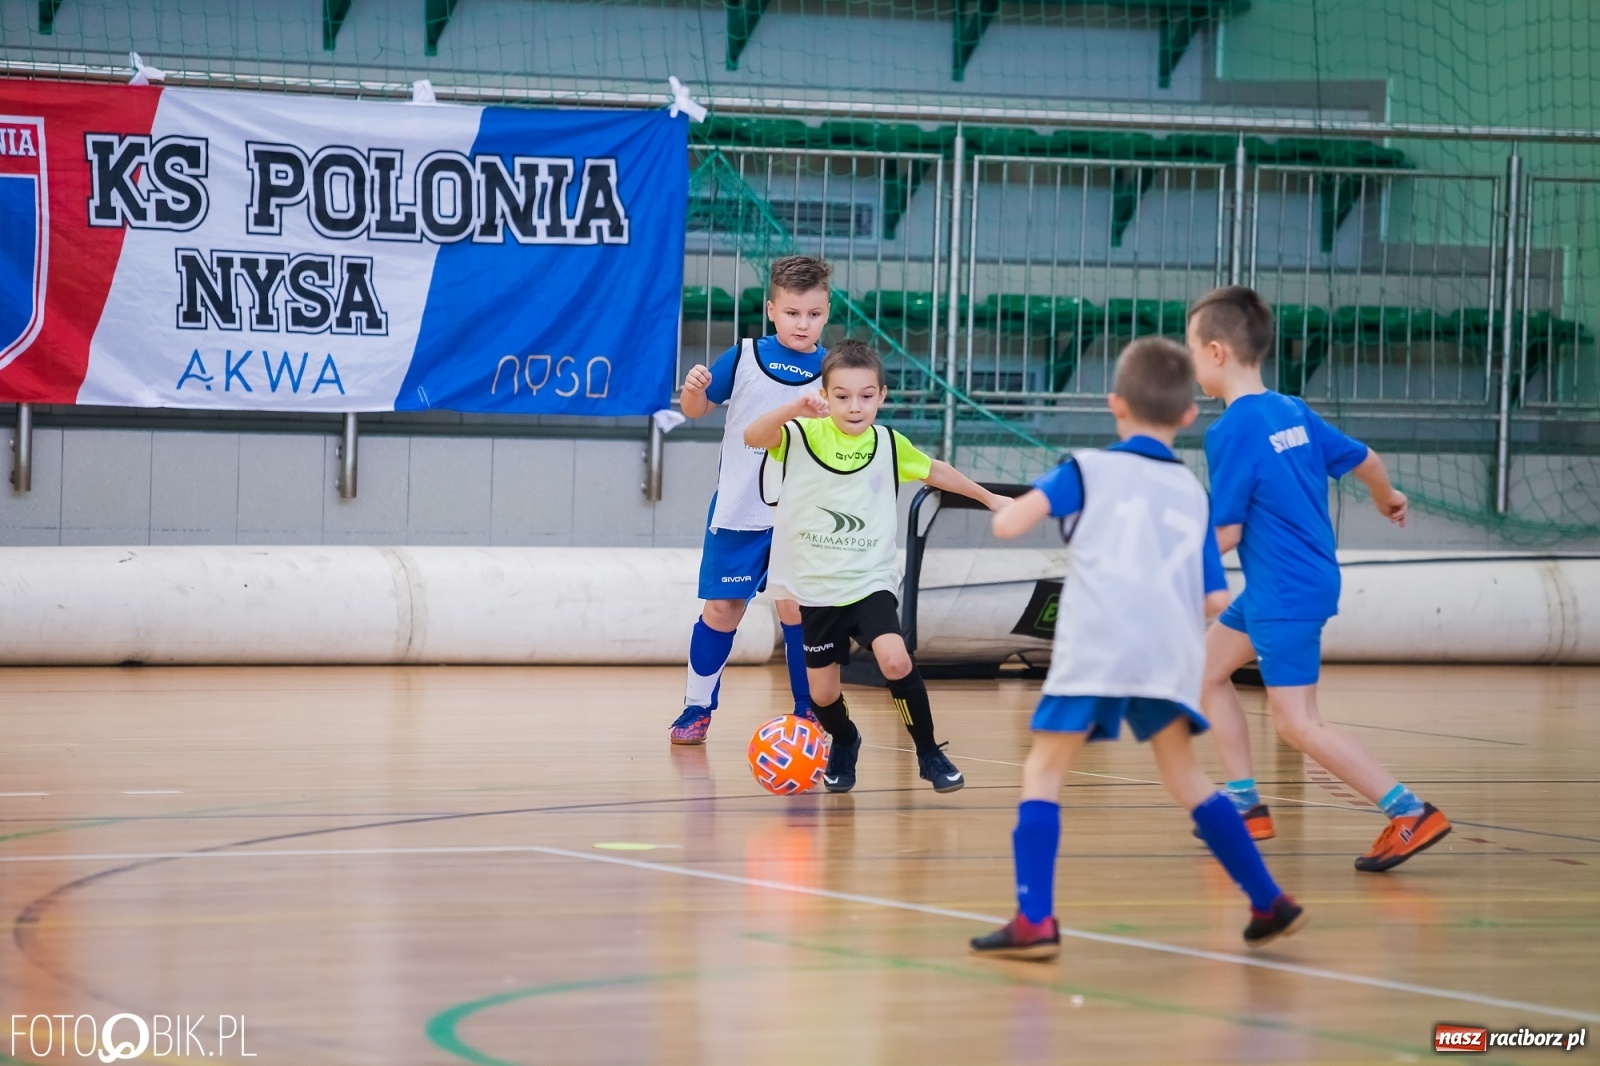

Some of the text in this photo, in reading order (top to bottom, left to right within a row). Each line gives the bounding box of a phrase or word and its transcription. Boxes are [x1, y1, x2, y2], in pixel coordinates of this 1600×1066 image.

[85, 133, 629, 245] KS POLONIA
[175, 248, 389, 336] NYSA
[176, 349, 346, 396] AKWA
[798, 532, 880, 548] YAKIMASPORT
[721, 575, 752, 583] GIVOVA
